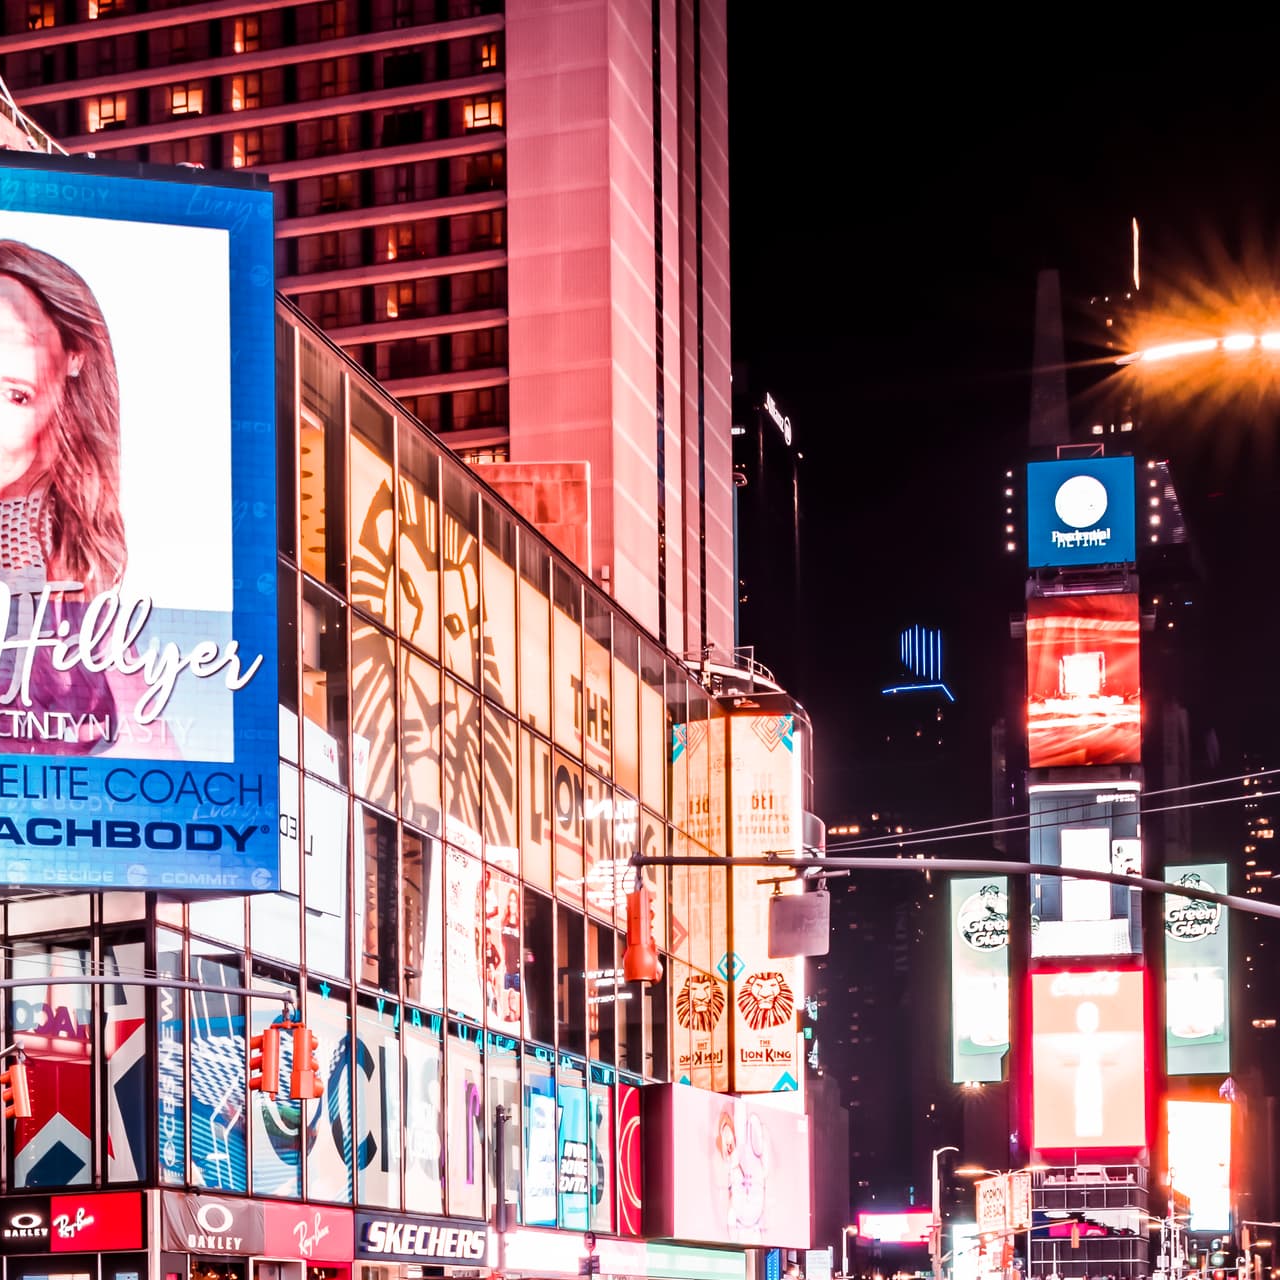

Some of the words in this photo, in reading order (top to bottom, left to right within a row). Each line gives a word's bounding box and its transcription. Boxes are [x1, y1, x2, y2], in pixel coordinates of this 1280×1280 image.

[570, 673, 610, 751] THE
[104, 767, 263, 807] COACH
[161, 872, 239, 888] COMMIT
[1167, 907, 1219, 922] Green
[1170, 920, 1220, 937] Giant
[970, 932, 1010, 946] Gian
[759, 1039, 771, 1047] THE
[740, 1048, 763, 1062] LION
[765, 1048, 792, 1062] KING
[3, 1227, 49, 1238] OAKLEY
[293, 1211, 330, 1256] Ray-Ban
[367, 1220, 486, 1260] SKECHERS
[187, 1234, 243, 1251] OAKLEY
